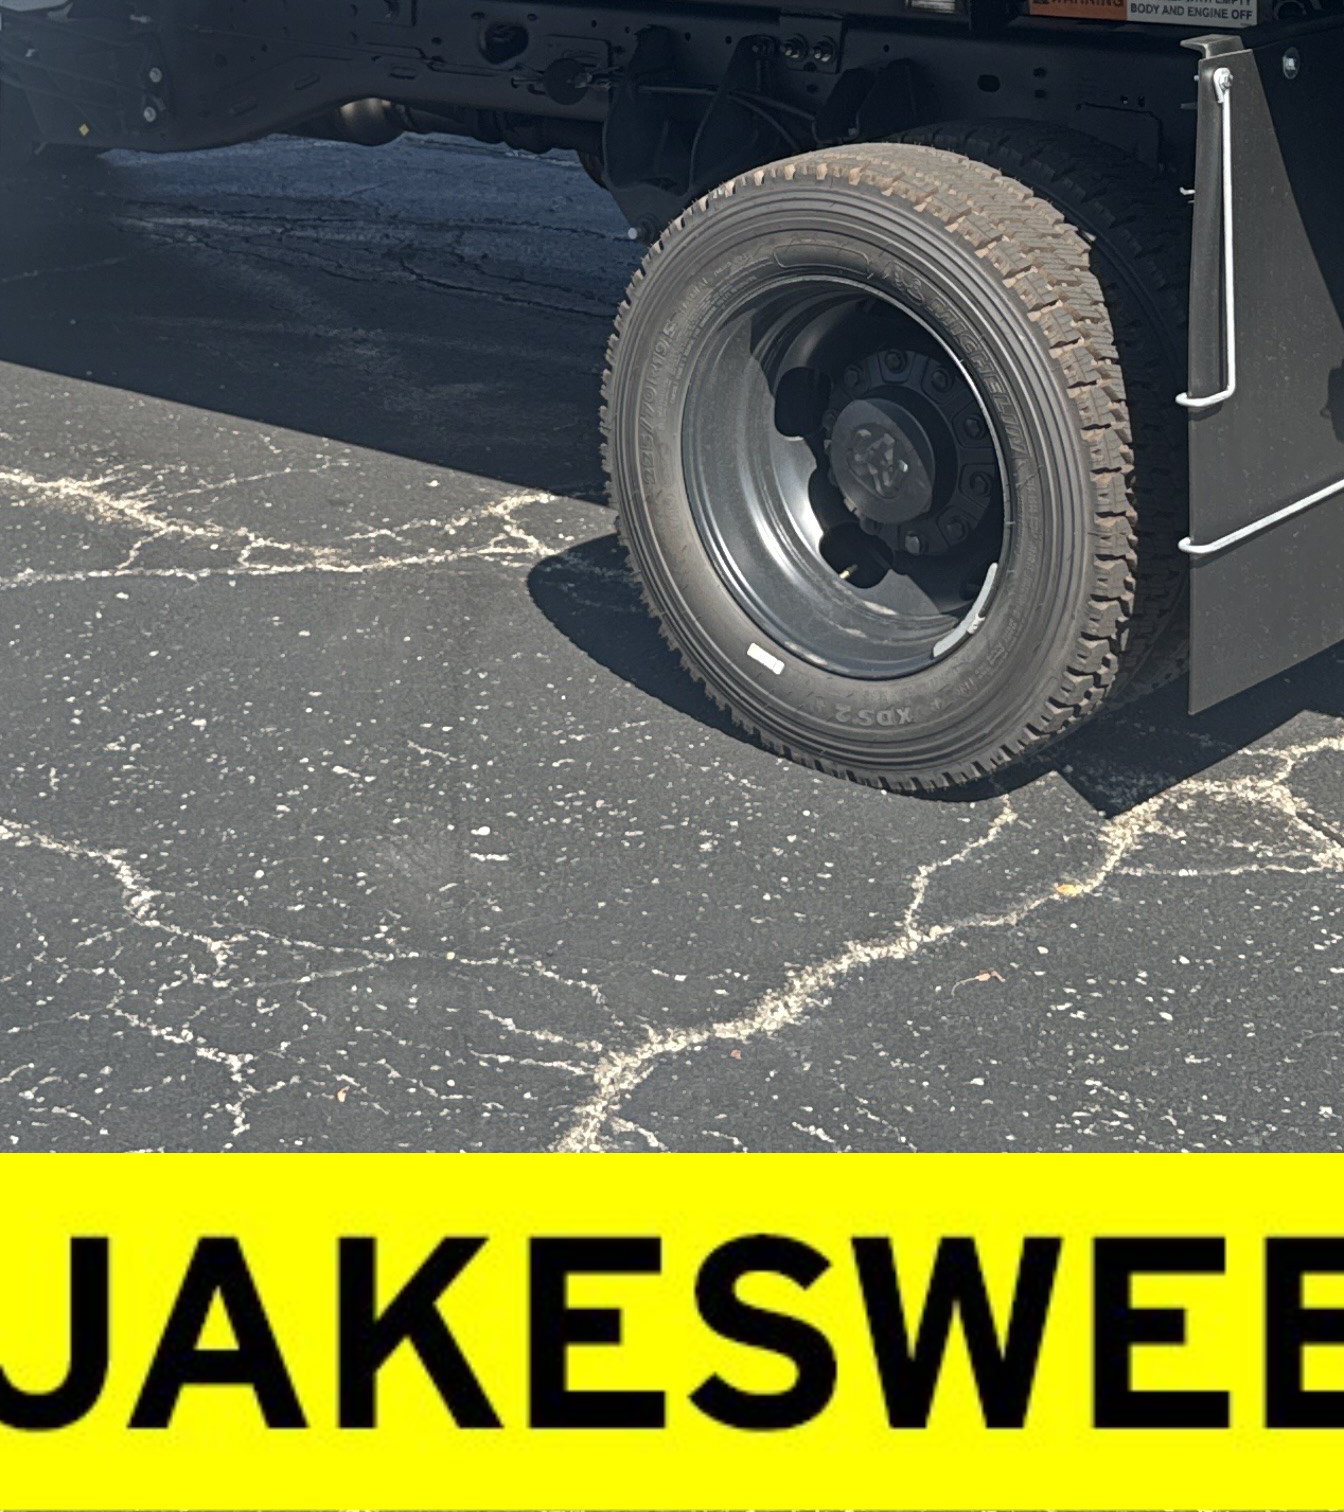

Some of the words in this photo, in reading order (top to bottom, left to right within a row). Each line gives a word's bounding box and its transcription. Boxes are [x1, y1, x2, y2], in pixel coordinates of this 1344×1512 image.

[1130, 2, 1158, 15] BODY
[1161, 4, 1185, 16] AND
[1187, 6, 1229, 19] ENGINE
[1230, 8, 1253, 20] OFF
